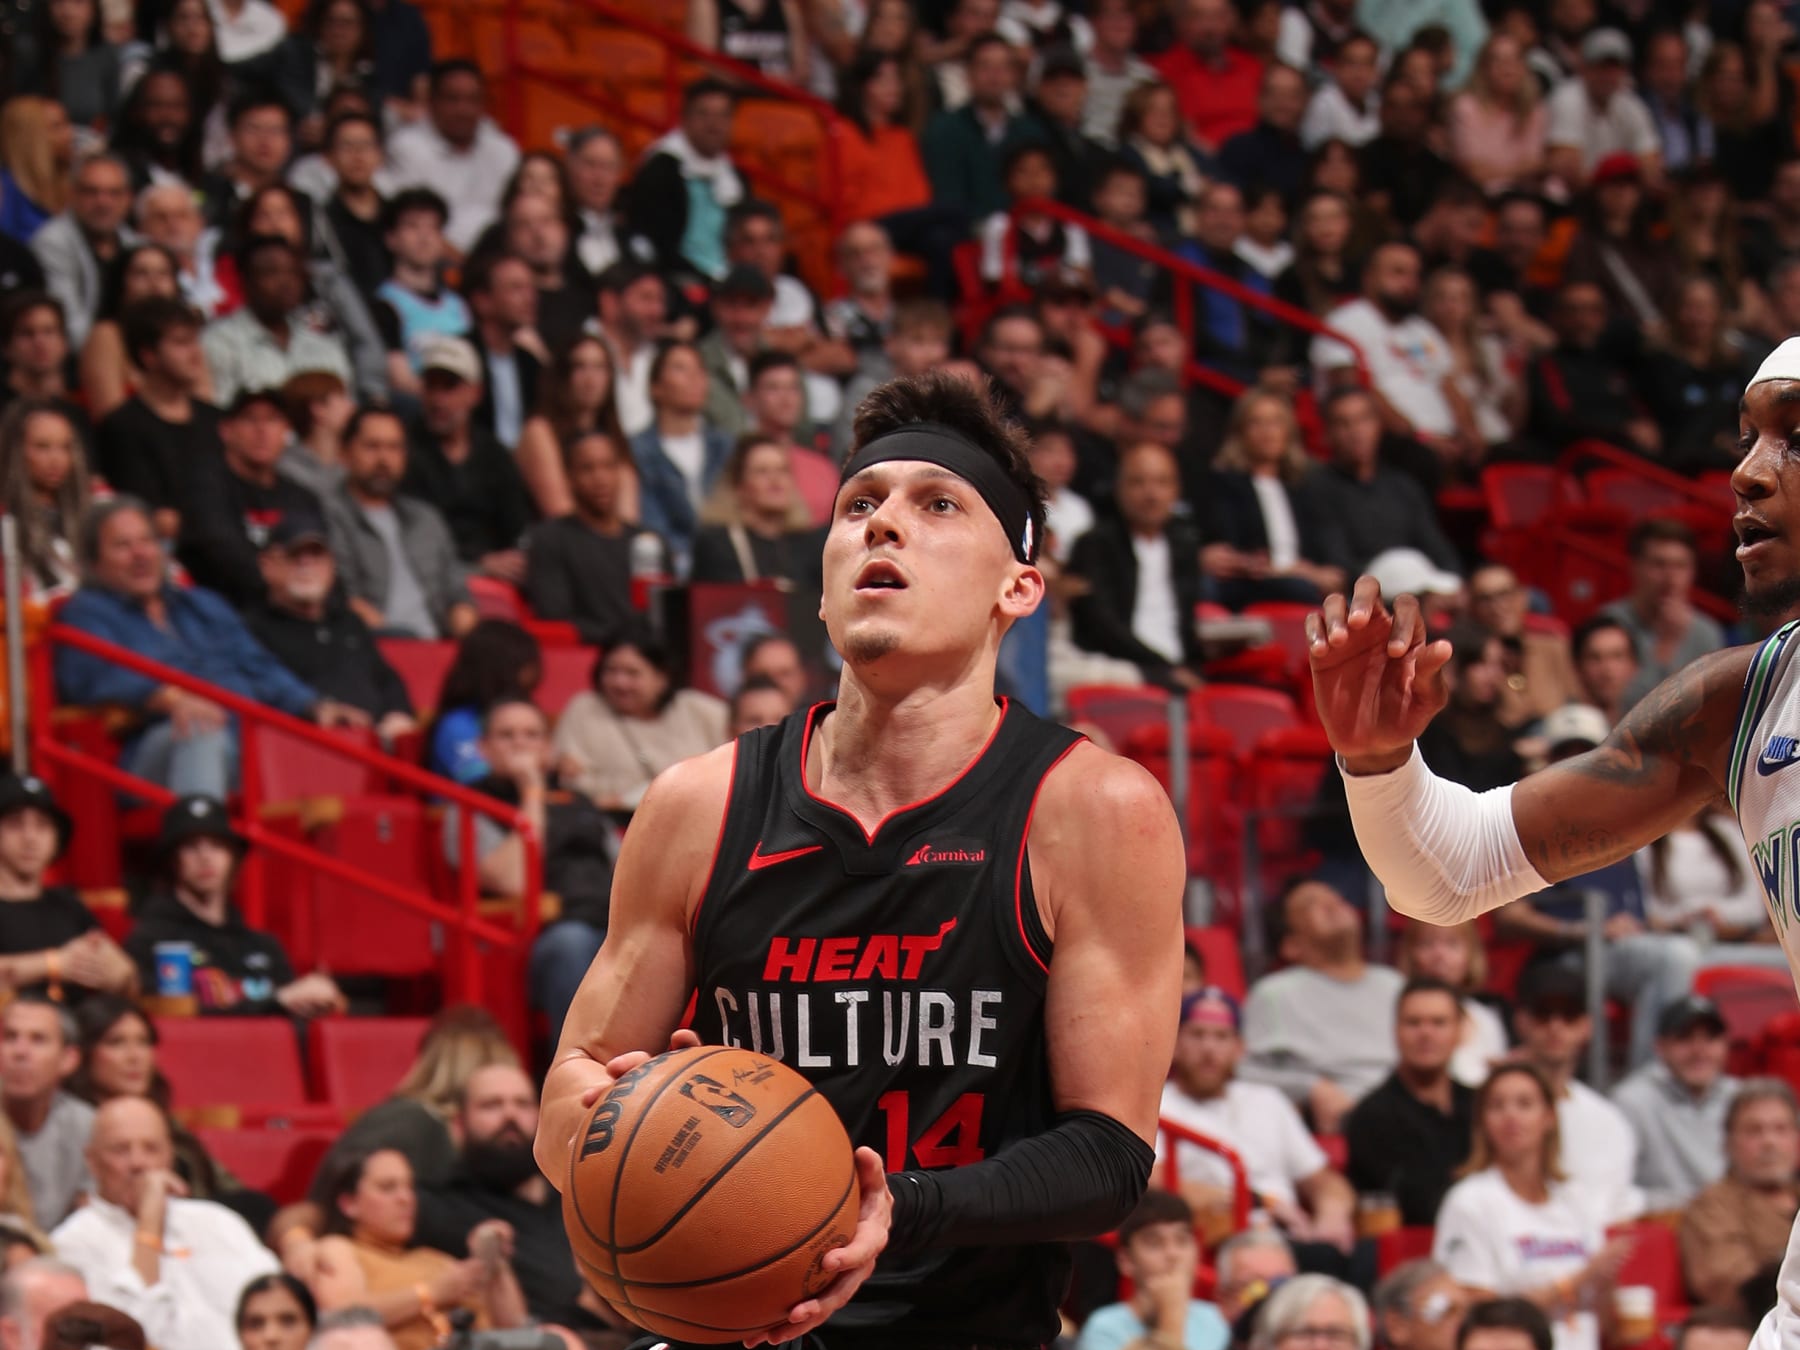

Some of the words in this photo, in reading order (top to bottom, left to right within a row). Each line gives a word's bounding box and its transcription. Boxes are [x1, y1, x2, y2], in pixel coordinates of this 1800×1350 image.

[917, 847, 985, 864] Carnival
[762, 917, 958, 982] HEAT
[713, 986, 1003, 1069] CULTURE
[877, 1090, 985, 1174] 14
